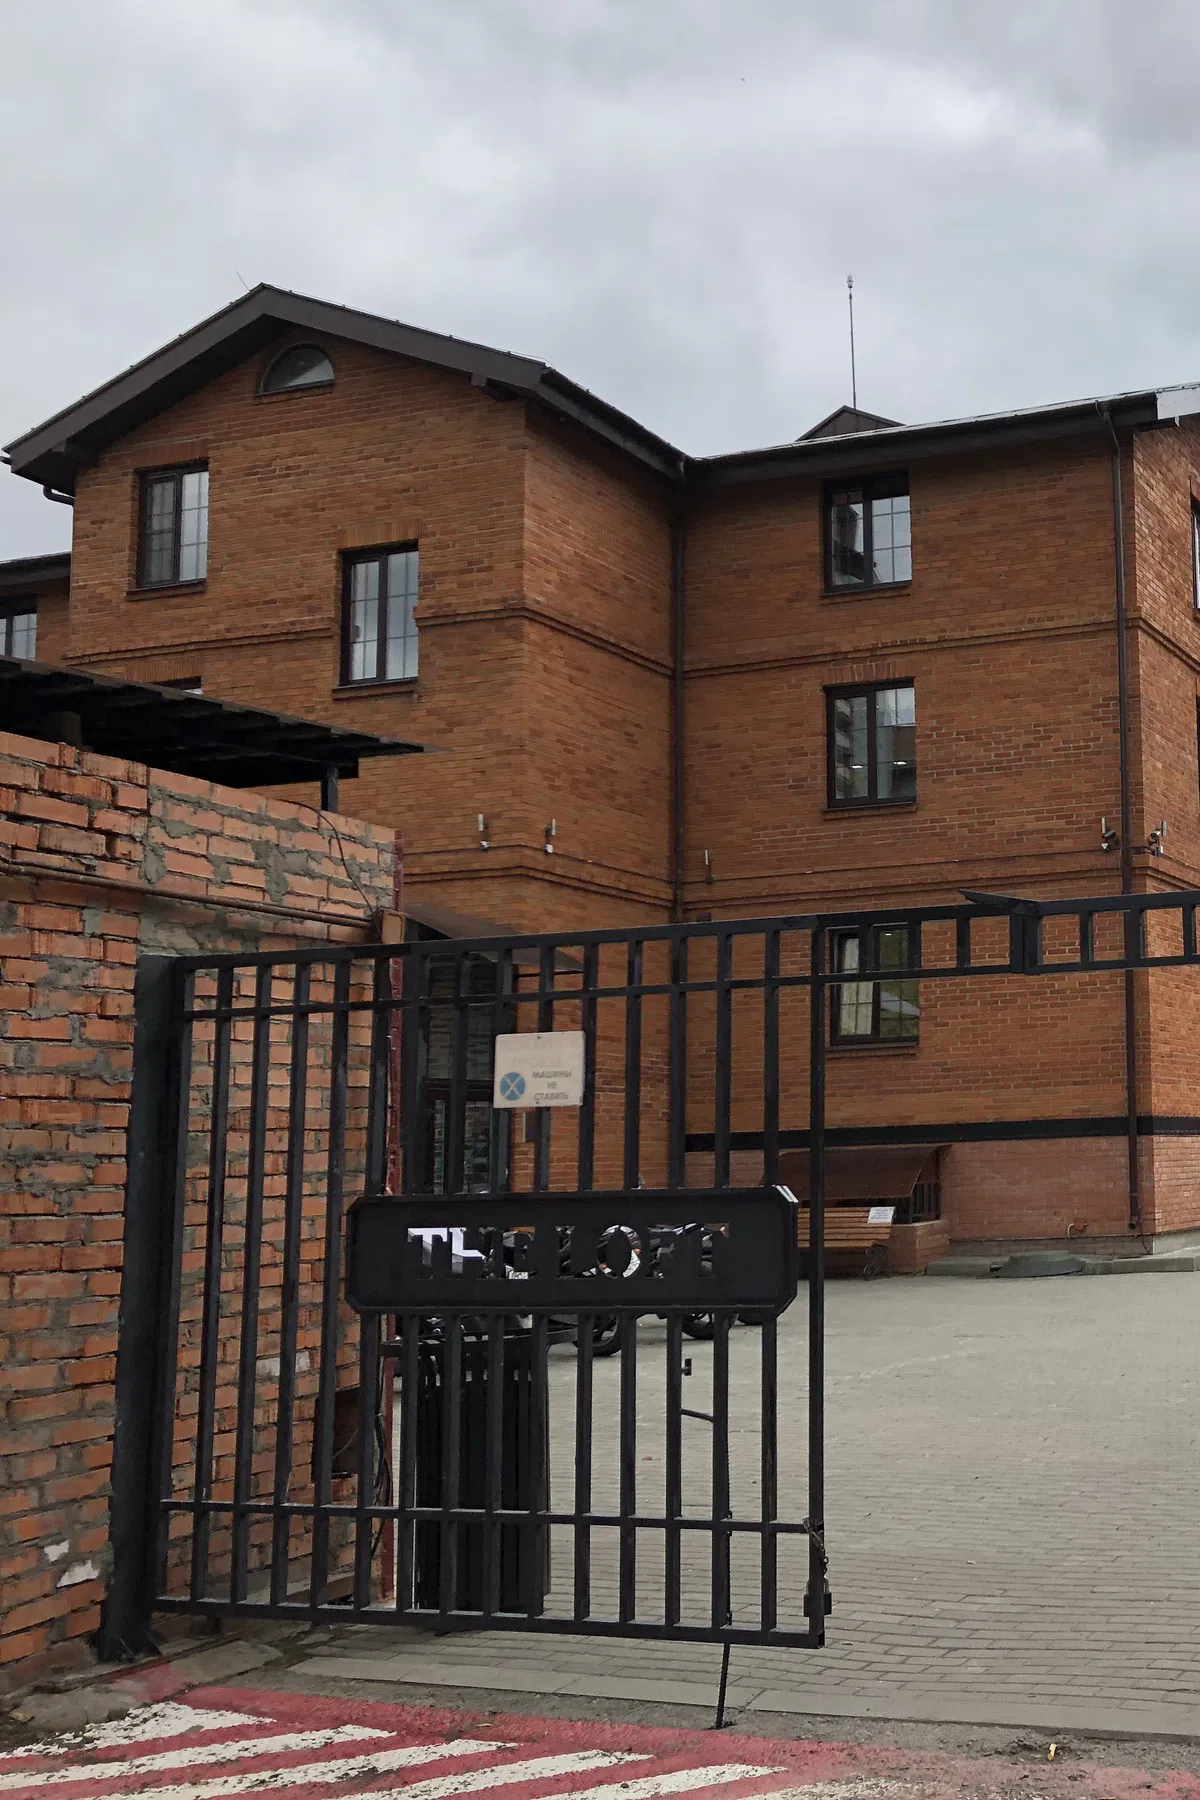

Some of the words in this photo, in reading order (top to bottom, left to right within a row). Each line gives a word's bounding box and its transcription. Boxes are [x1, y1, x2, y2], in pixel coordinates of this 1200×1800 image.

[532, 1070, 572, 1079] МАШИНЫ
[547, 1081, 558, 1089] НЕ
[533, 1092, 569, 1101] СТАВИТЬ
[407, 1225, 540, 1280] THE
[553, 1223, 730, 1280] LOFT
